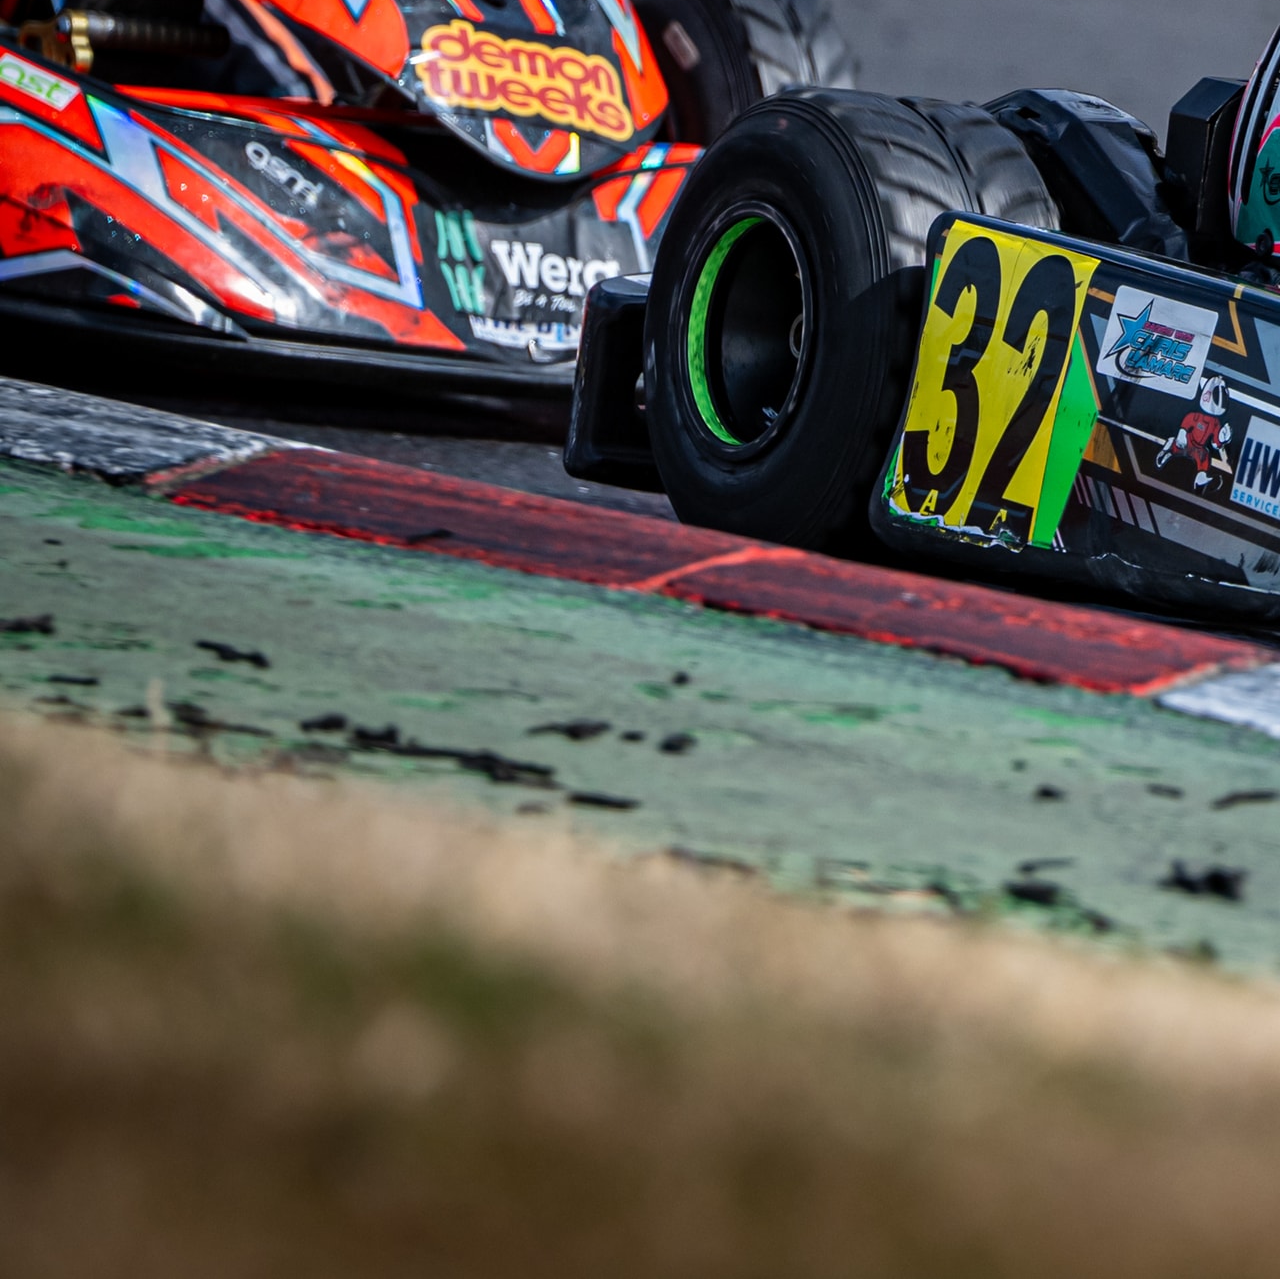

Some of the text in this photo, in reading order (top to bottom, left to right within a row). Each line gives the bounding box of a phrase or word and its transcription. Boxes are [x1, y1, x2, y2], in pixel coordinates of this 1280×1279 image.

[424, 61, 627, 133] tweeks
[430, 28, 617, 97] demon
[1132, 328, 1193, 363] CHRIS
[902, 236, 1076, 545] 32
